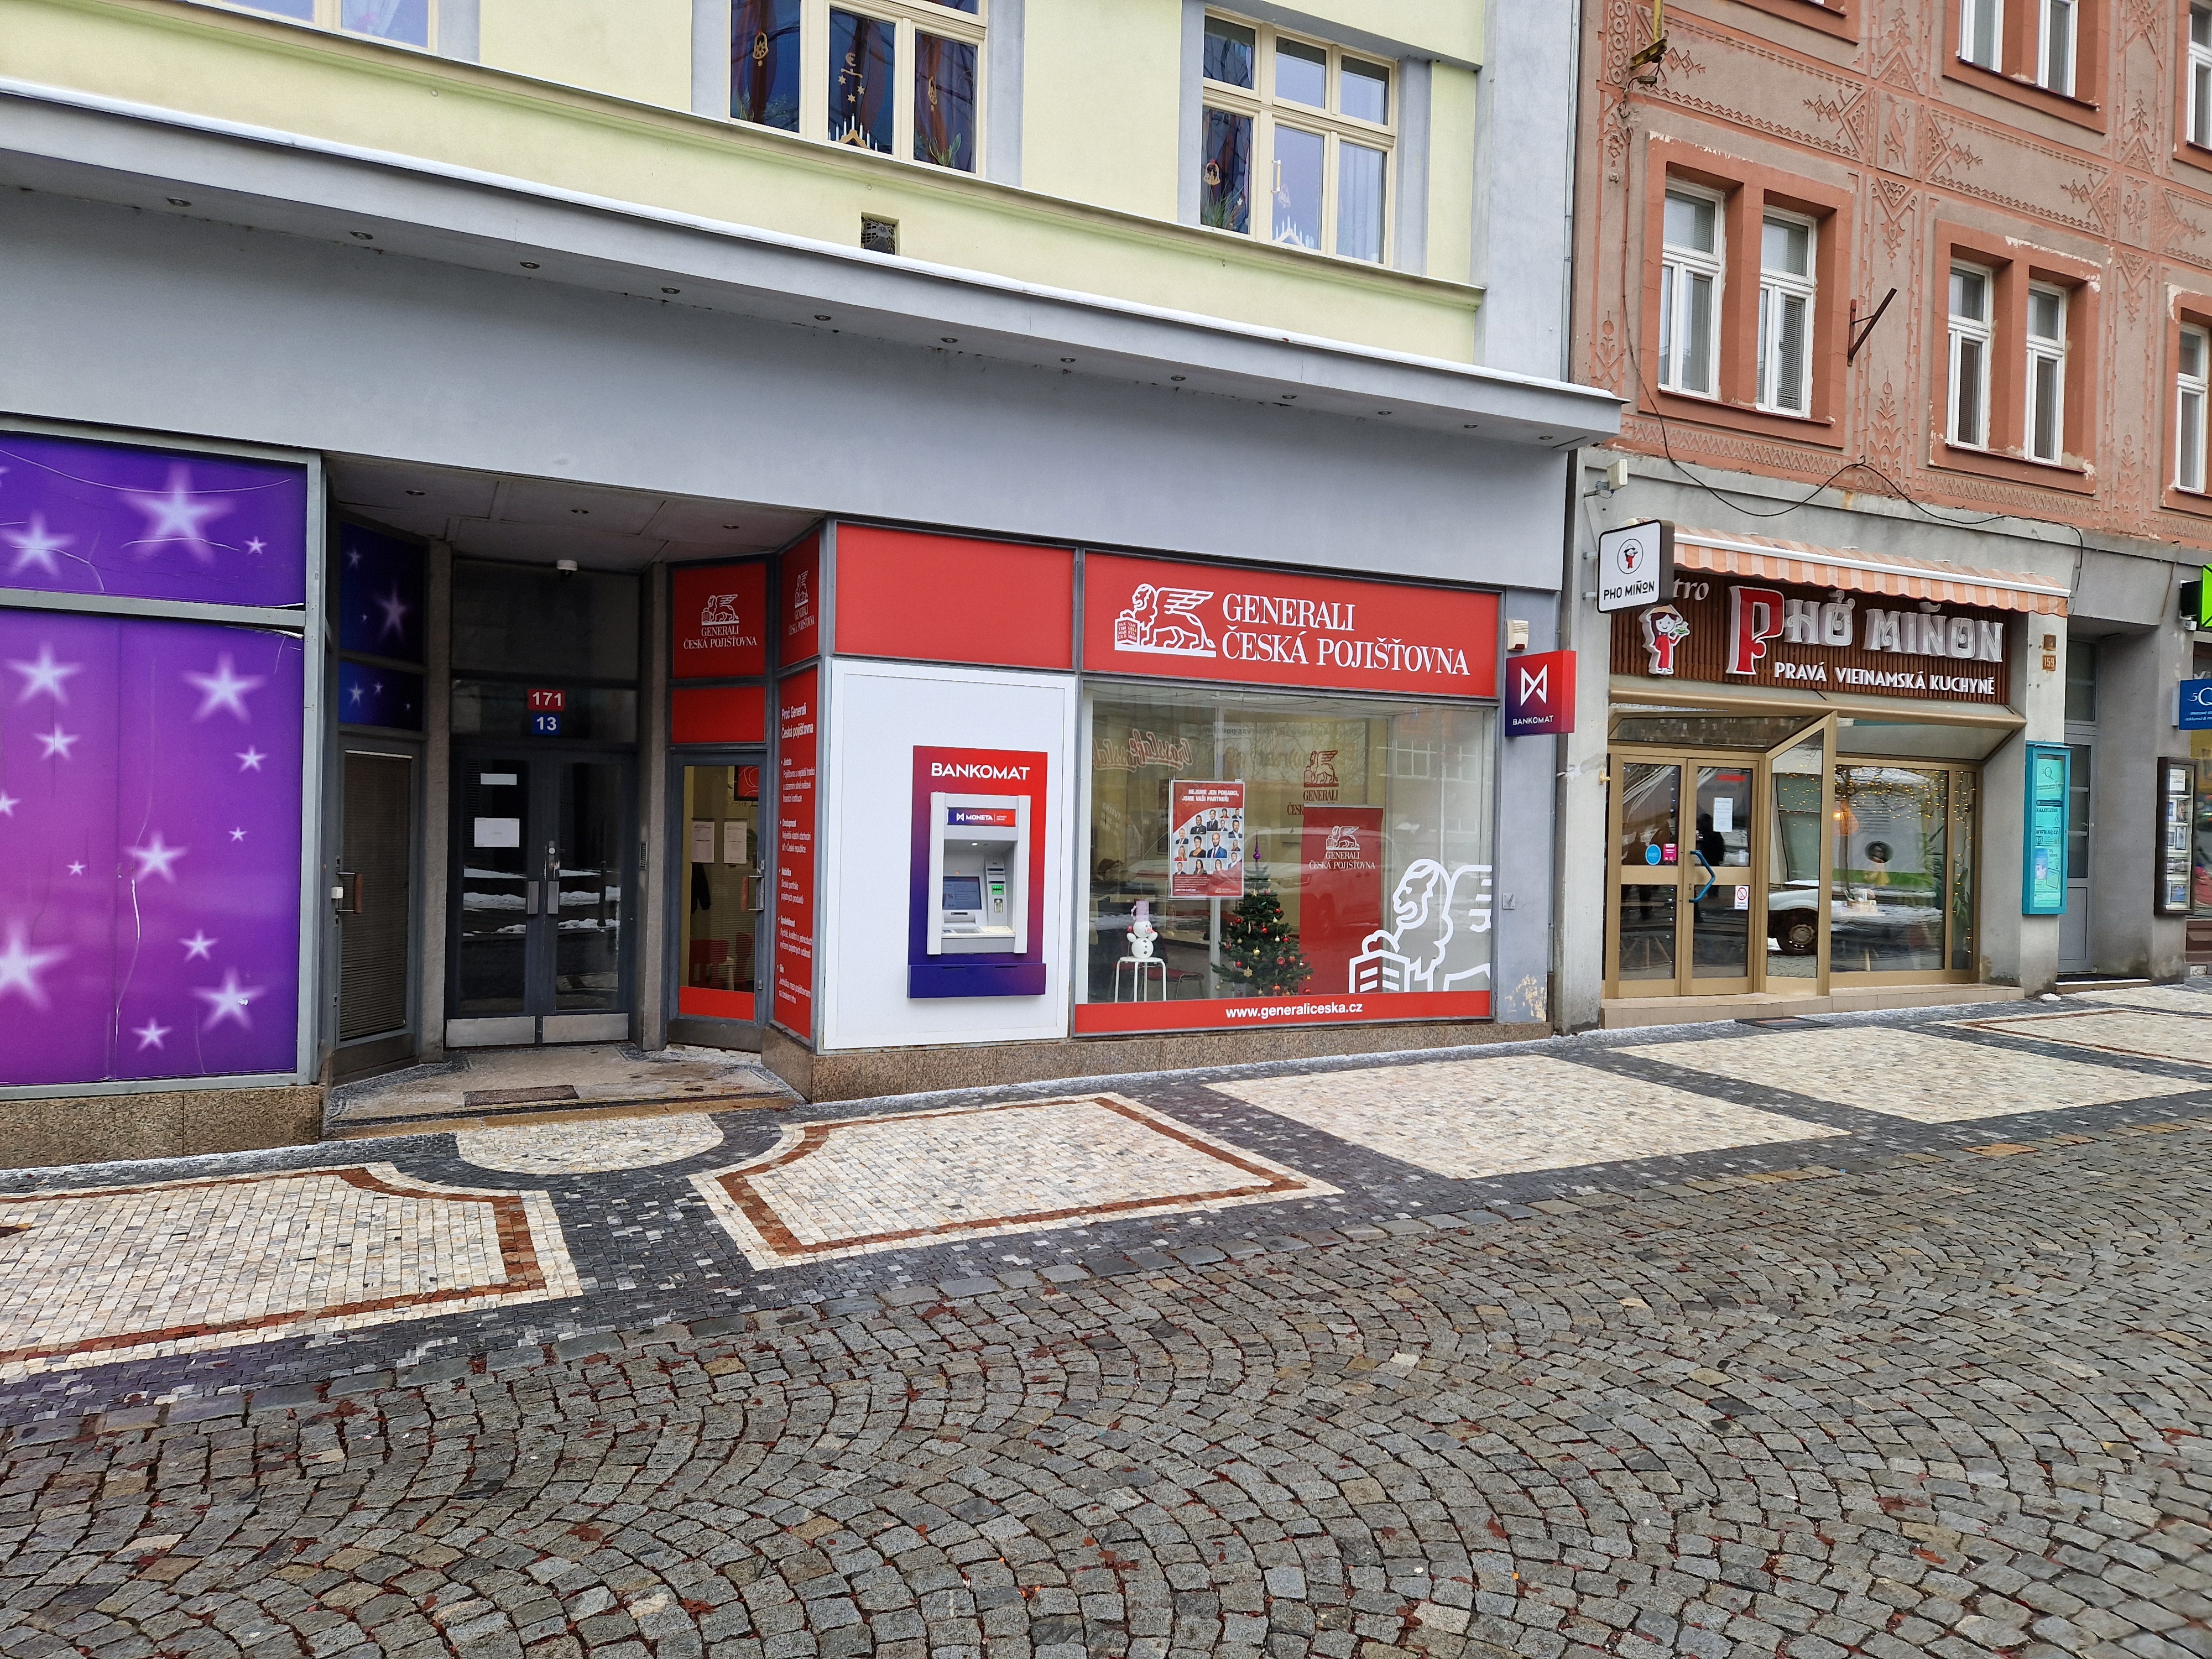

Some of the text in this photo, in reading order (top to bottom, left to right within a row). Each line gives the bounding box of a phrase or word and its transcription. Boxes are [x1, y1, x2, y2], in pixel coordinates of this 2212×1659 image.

[1604, 587, 1623, 601] PHO
[1673, 578, 1709, 601] tro
[1222, 593, 1355, 632] GENERALI
[701, 625, 739, 637] GENERALI
[684, 635, 758, 649] ČESKÁ POJIŠŤOVNA
[1222, 625, 1470, 676] ČESKÁ POJIŠŤOVNA
[2044, 657, 2055, 667] 159
[1775, 661, 1995, 695] PRAVÁ VIETNAMSKÁ KUCHYNĚ
[533, 692, 561, 707] 171
[781, 702, 807, 720] Proč Generali
[536, 716, 557, 731] 13
[1512, 715, 1554, 726] BANKOMAT
[781, 722, 813, 739] Česká pojišťovna
[931, 762, 1030, 780] BANKOMAT
[1303, 790, 1338, 801] GENERALI
[1287, 802, 1304, 816] ČESK
[1326, 851, 1360, 859] GENERALI
[1309, 859, 1375, 869] ČESKÁ POJIŠŤOVNA
[1225, 1001, 1363, 1019] www.generaliceska.cz
